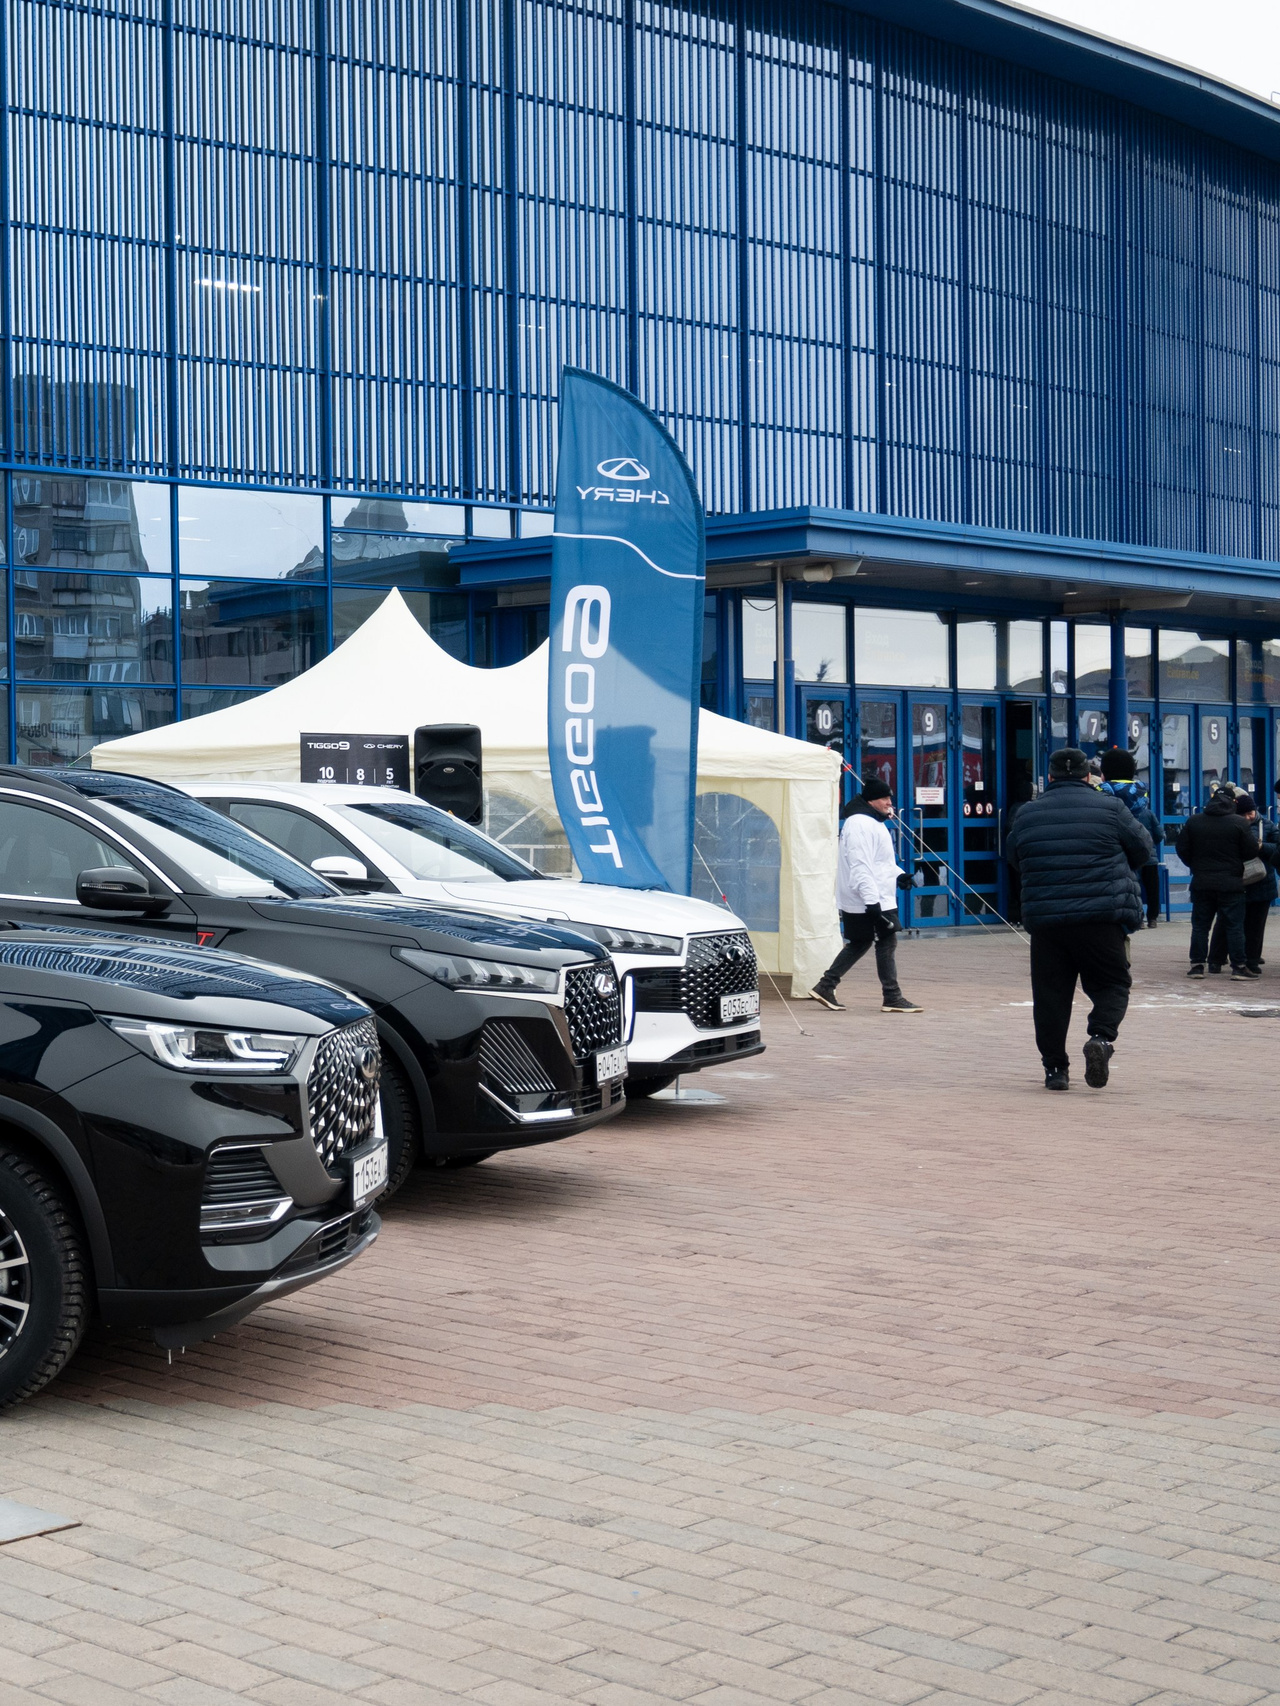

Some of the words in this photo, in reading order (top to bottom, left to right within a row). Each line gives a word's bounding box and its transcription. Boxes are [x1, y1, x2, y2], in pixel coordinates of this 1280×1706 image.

[817, 709, 832, 730] 10
[924, 712, 934, 732] 9
[1090, 718, 1098, 736] 7
[1131, 720, 1140, 738] 6
[1211, 723, 1219, 740] 5
[319, 766, 334, 779] 10
[356, 768, 365, 780] 8
[386, 768, 394, 780] 5
